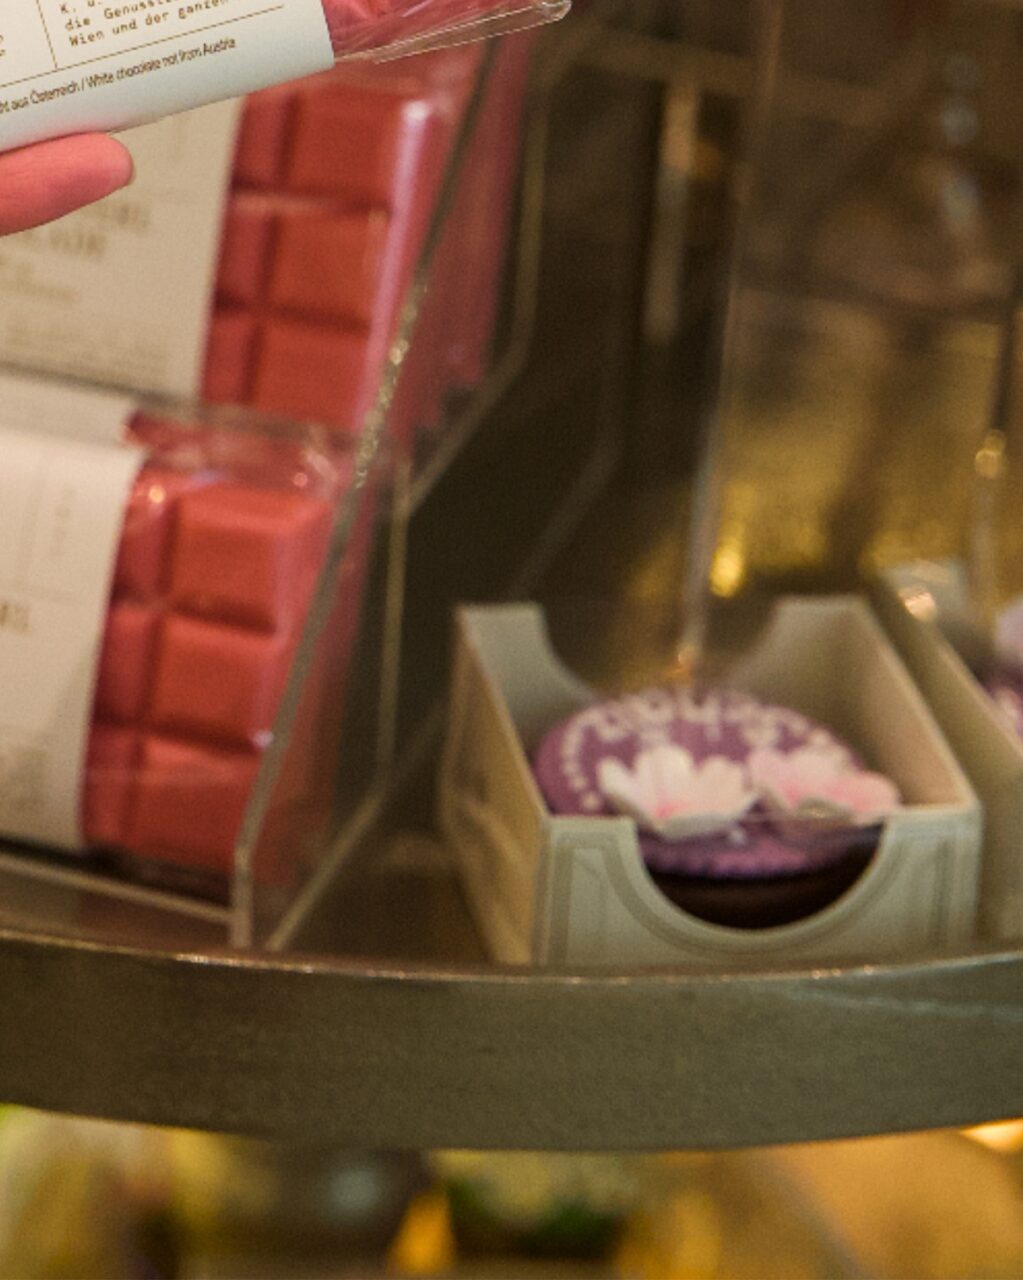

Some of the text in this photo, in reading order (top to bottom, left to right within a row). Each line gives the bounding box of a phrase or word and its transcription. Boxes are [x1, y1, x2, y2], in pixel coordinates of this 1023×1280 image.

[60, 3, 77, 14] K.
[65, 17, 91, 31] die
[69, 29, 104, 47] Wien
[112, 19, 137, 35] und
[145, 11, 170, 27] der
[11, 97, 29, 112] aus
[29, 79, 79, 106] Österreich
[86, 70, 115, 89] White
[116, 57, 160, 81] chocolate
[160, 53, 179, 69] not
[178, 47, 202, 64] from
[202, 37, 236, 58] Austria
